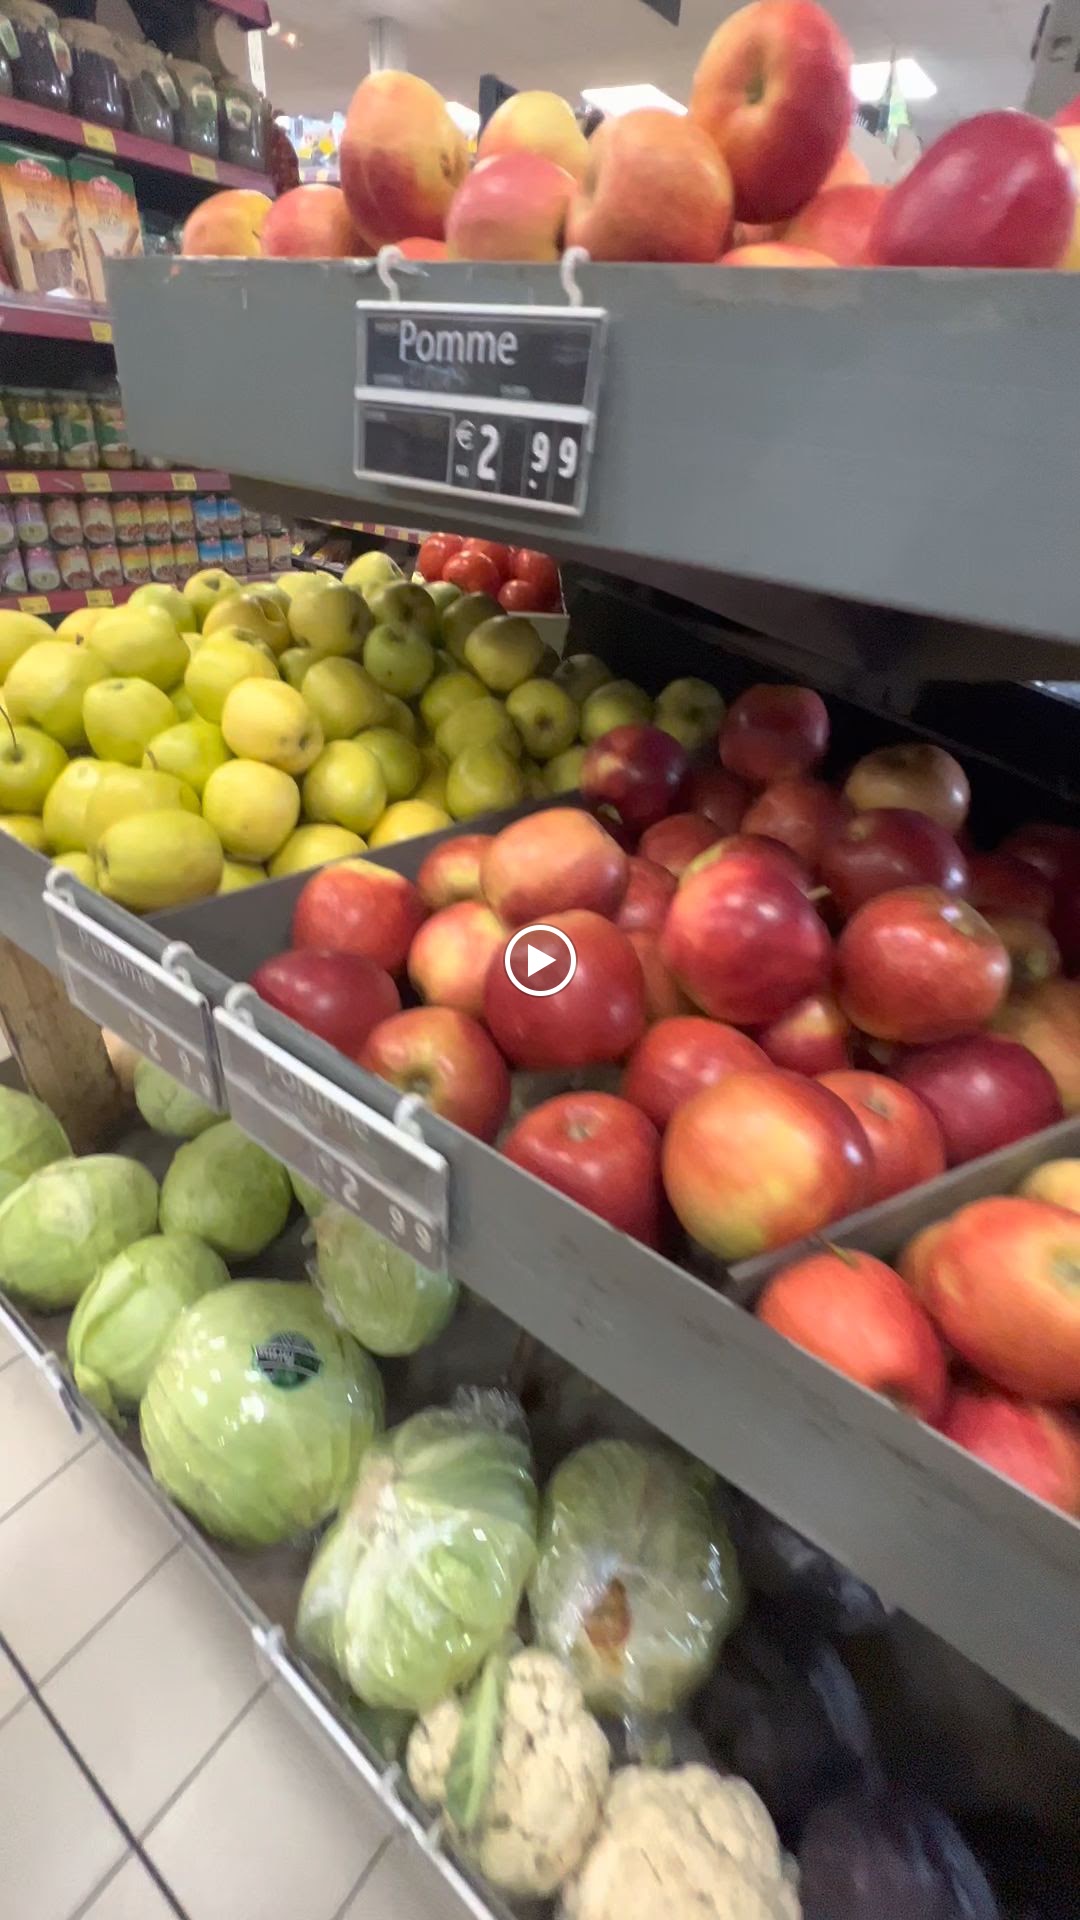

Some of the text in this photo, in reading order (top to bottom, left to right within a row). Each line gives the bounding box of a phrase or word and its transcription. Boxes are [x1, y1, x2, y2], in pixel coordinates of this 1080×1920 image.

[399, 319, 519, 366] Pomme
[78, 926, 156, 994] Pomme
[264, 1057, 370, 1143] Pomme
